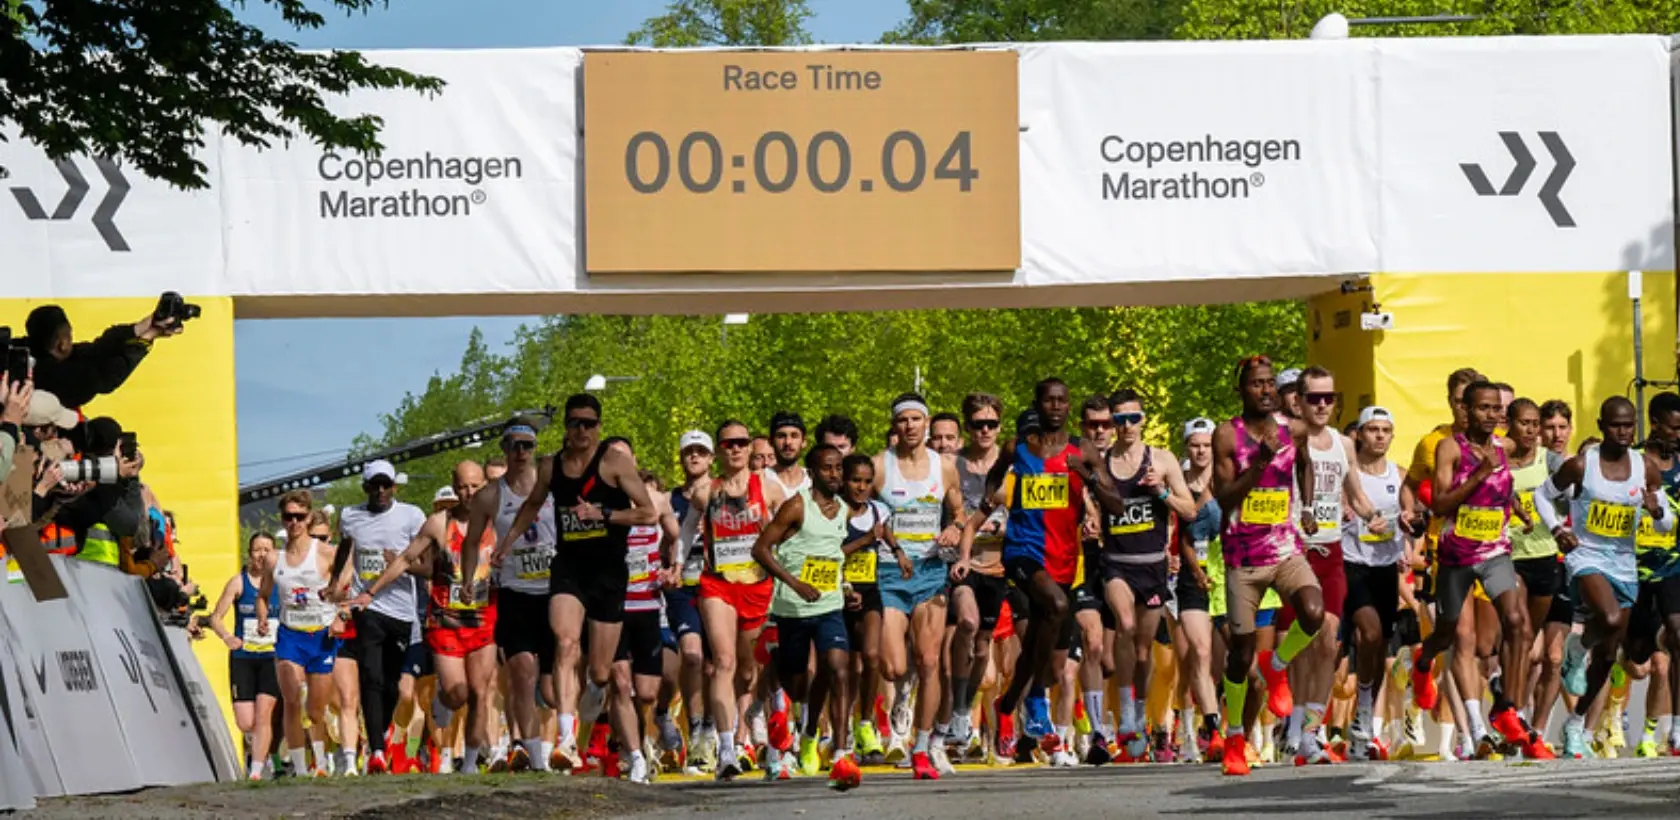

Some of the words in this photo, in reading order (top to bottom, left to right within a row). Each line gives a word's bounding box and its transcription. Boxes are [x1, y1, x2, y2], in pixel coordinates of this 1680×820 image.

[723, 65, 797, 91] Race
[806, 65, 882, 91] Time
[625, 130, 979, 194] 00:00.04
[1100, 134, 1301, 168] Copenhagen
[318, 151, 522, 186] Copenhagen
[1026, 479, 1065, 502] Korir
[1245, 495, 1286, 516] Tesfaye
[1458, 512, 1500, 532] Tadesse
